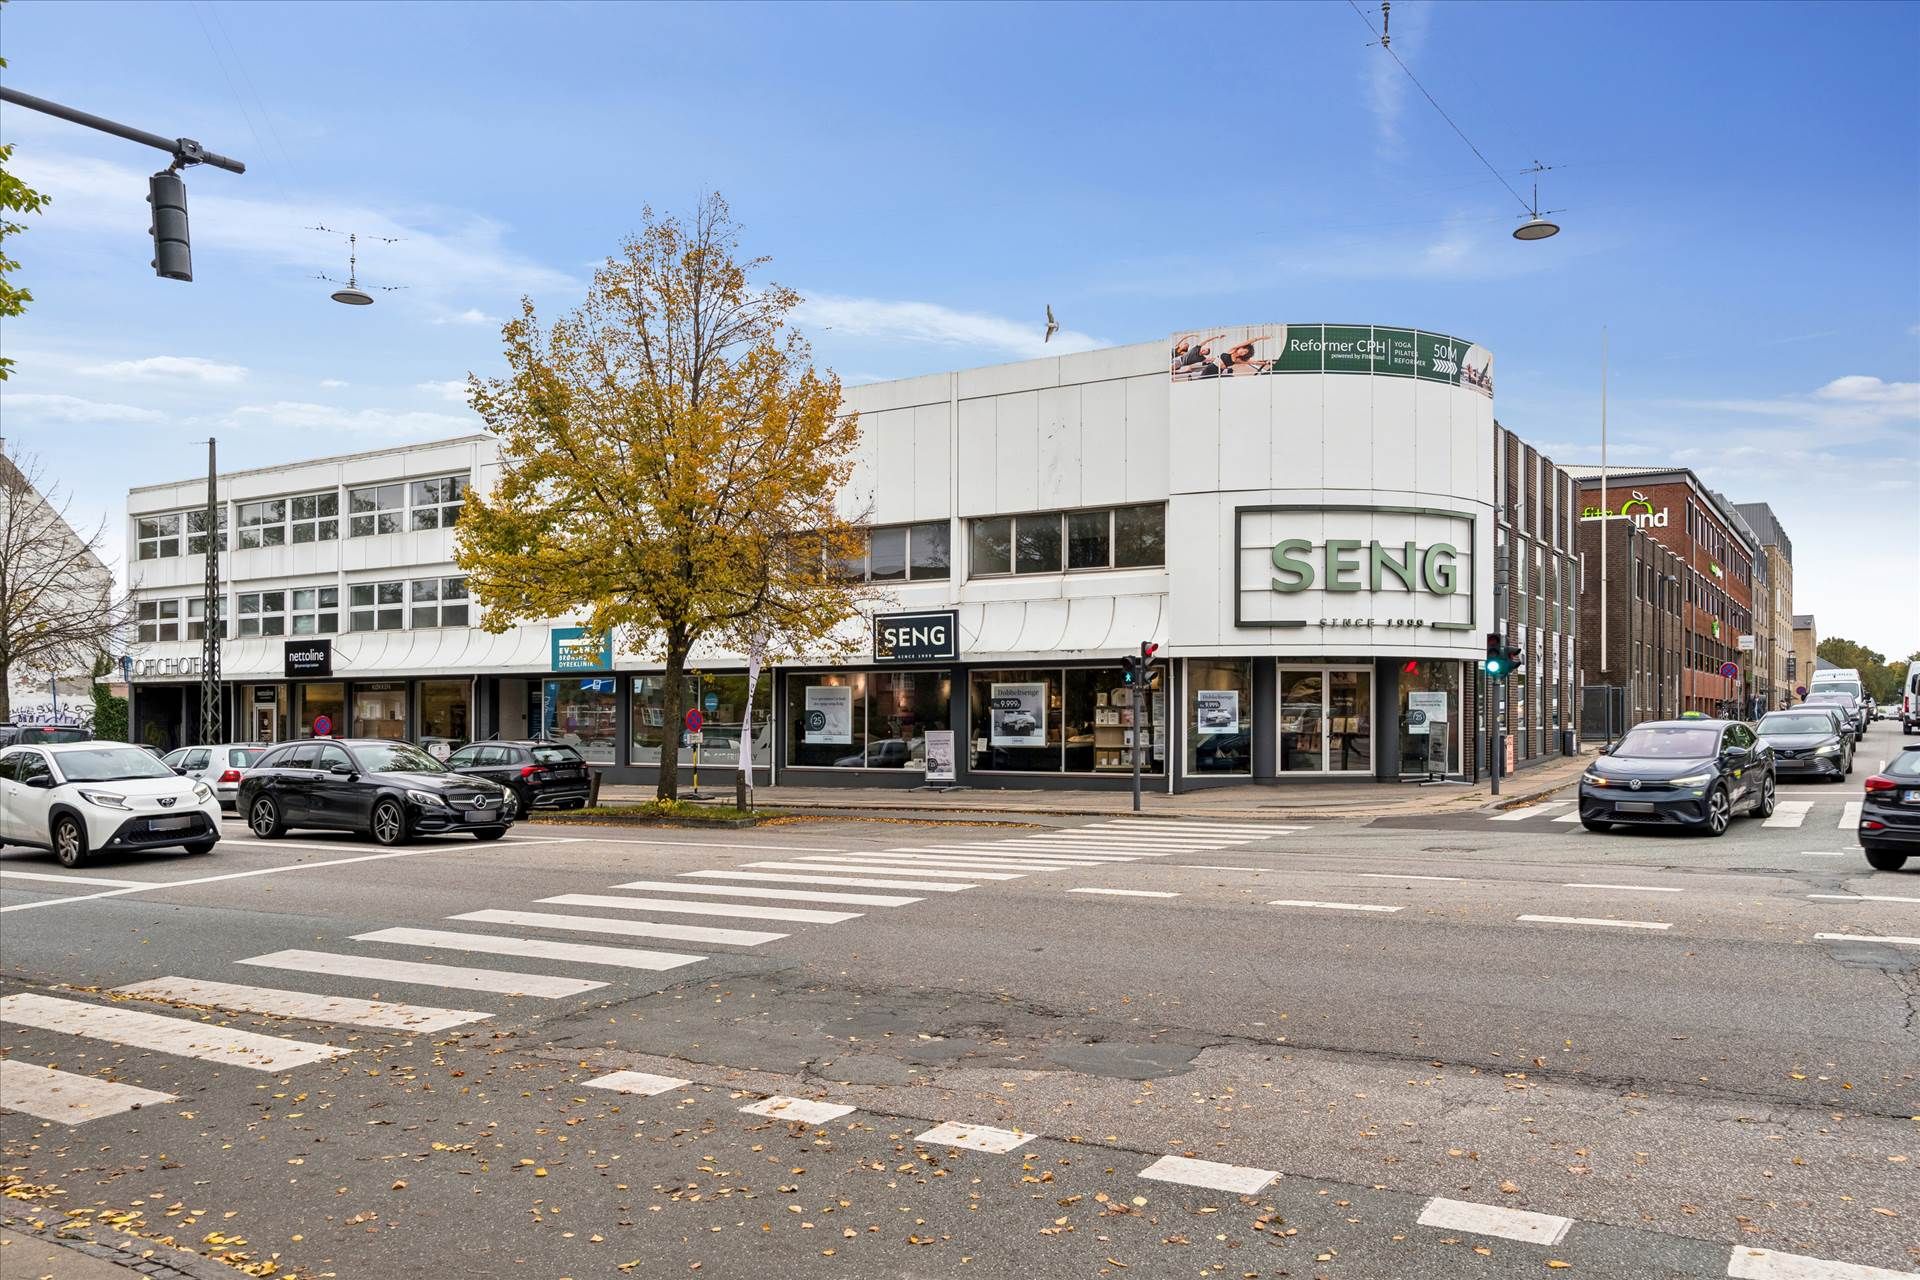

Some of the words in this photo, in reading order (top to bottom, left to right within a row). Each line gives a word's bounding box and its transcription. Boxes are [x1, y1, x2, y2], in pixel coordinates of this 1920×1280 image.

[1291, 339, 1354, 352] Reformer
[1356, 340, 1385, 353] CPH
[1394, 349, 1419, 357] PILATES
[1433, 344, 1457, 361] 50M
[1394, 358, 1426, 366] REFORMER
[1271, 538, 1457, 596] SENG
[1319, 618, 1375, 629] SINCE
[1386, 618, 1424, 630] 1999
[884, 625, 945, 648] SENG
[289, 648, 324, 662] nettoline
[814, 716, 822, 724] 25
